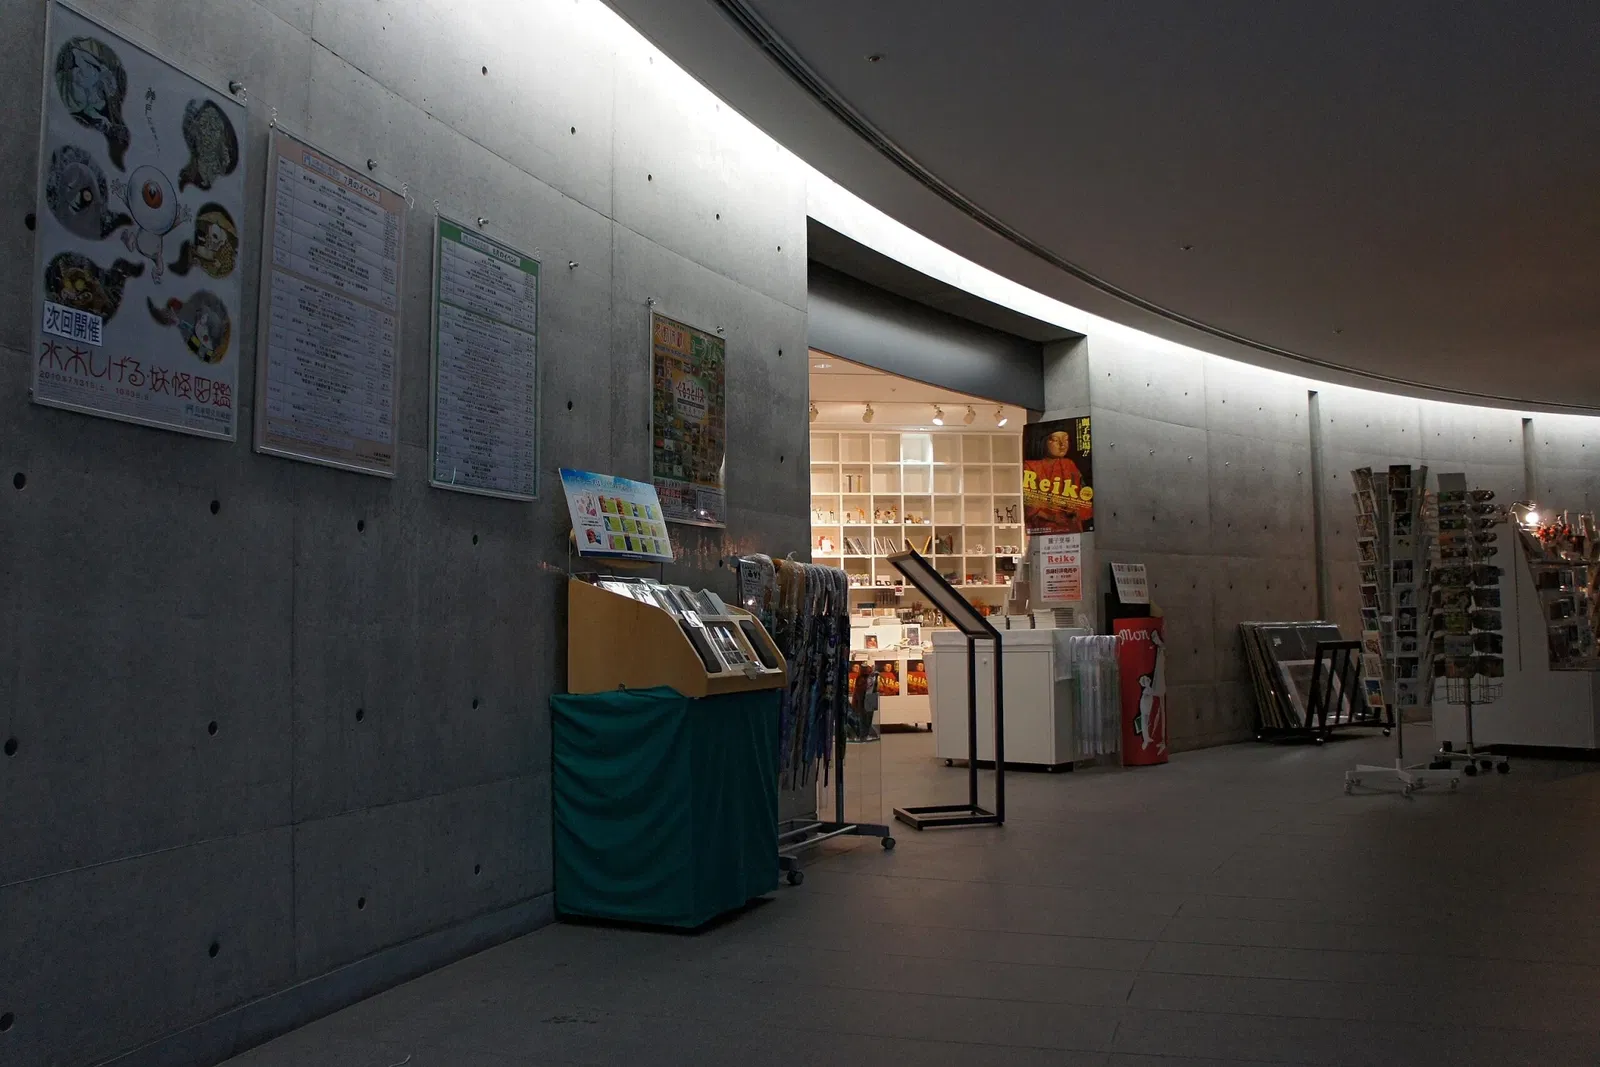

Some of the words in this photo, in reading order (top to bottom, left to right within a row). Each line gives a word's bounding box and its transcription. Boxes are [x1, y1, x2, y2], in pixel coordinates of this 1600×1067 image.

[343, 176, 377, 199] 7月のイベント
[46, 306, 101, 343] 次回開催
[1023, 469, 1093, 501] Reiko
